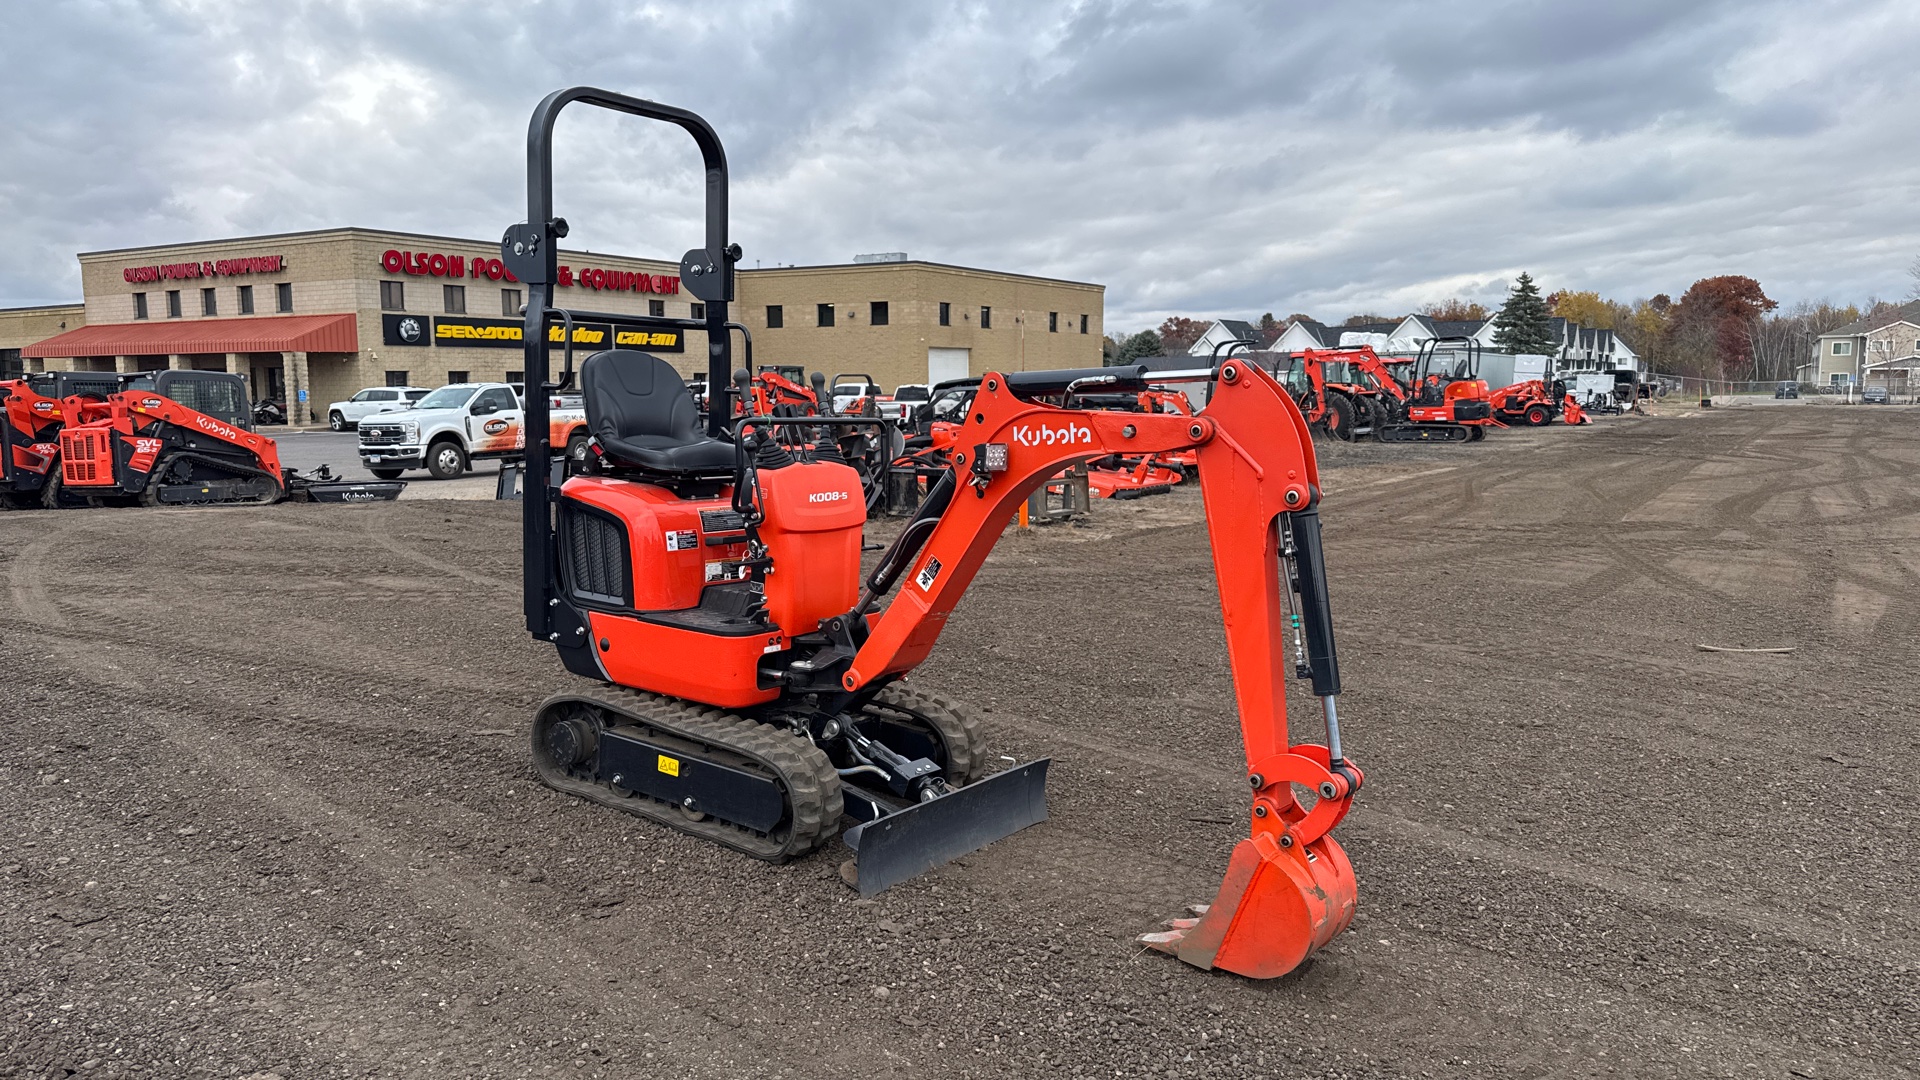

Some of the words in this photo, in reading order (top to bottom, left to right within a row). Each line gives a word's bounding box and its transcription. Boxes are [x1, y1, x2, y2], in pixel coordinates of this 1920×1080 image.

[123, 266, 158, 282] OLSON
[160, 262, 199, 280] POWER
[215, 255, 281, 276] EQUIPMENT
[383, 249, 465, 278] OLSON
[557, 266, 574, 287] &
[579, 268, 680, 295] EQUIPMENT
[196, 415, 236, 440] Kubota
[1013, 422, 1091, 447] Kubota
[136, 439, 161, 447] SVL
[809, 491, 848, 503] K008-5
